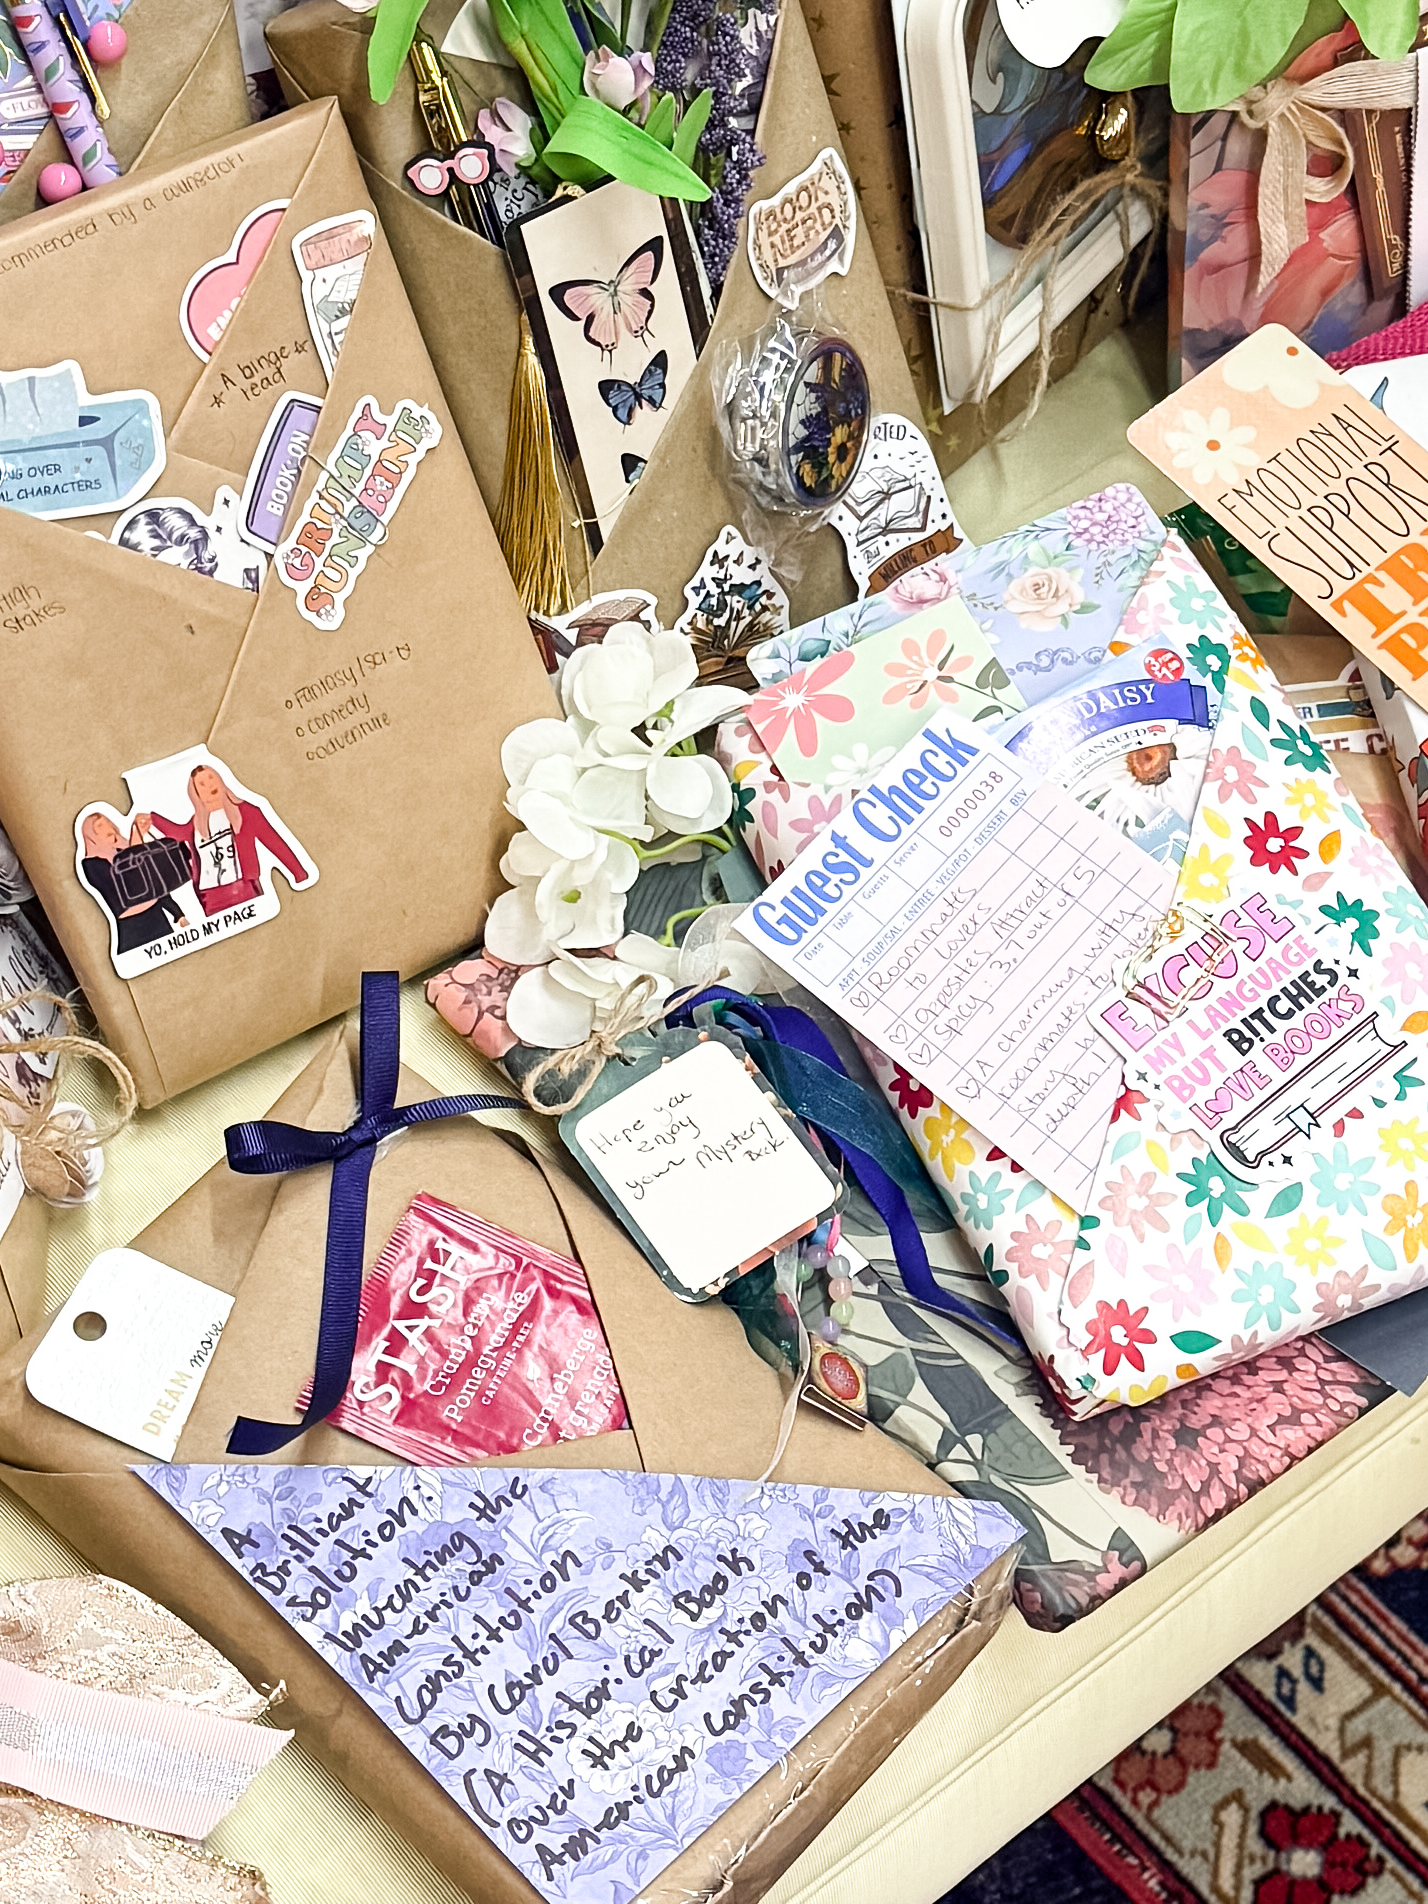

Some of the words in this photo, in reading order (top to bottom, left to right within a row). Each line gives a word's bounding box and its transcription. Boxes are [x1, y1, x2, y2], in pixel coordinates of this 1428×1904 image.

[108, 204, 138, 228] by
[143, 196, 156, 212] a
[765, 171, 831, 235] BOOK
[770, 201, 837, 269] NERD
[219, 372, 237, 392] A
[237, 343, 292, 387] binge
[238, 367, 288, 402] read
[17, 479, 102, 501] CHARACTERS
[27, 464, 63, 478] OVER
[282, 402, 388, 582] GRUMPY
[305, 406, 432, 617] SUNSHINE
[1217, 403, 1400, 540] EMOTIONAL
[877, 548, 923, 584] WILLING
[924, 539, 937, 557] TO
[1076, 683, 1157, 720] DAISY
[752, 831, 875, 947] Guest
[852, 725, 981, 845] Check
[938, 769, 1005, 839] 0000038
[904, 887, 936, 924] ENTREE
[975, 809, 1010, 849] DESSERT
[1074, 865, 1096, 887] 5
[168, 928, 200, 950] HOLD
[203, 919, 220, 937] MY
[223, 904, 256, 929] PAGE
[869, 884, 978, 996] Roommates
[905, 970, 928, 992] to
[1100, 892, 1296, 1053] EXCUSE
[1143, 1032, 1188, 1076] MY
[1186, 934, 1318, 1041] LANGUAGE
[1263, 984, 1365, 1072] BOOKS
[653, 1092, 693, 1127] you
[1163, 1044, 1228, 1104] BUT
[625, 1158, 686, 1200] your
[695, 1116, 774, 1169] Mystery
[352, 1237, 478, 1416] STASH
[426, 1292, 499, 1397] Cranberry
[443, 1290, 529, 1423] Pomegranate
[481, 1321, 534, 1406] CAFFEINE-FREE
[142, 1370, 194, 1437] DREAM
[522, 1326, 599, 1447] Canneberge
[220, 1526, 260, 1559] A
[250, 1476, 373, 1597] Brilliant
[324, 1530, 482, 1653] Inventing
[468, 1475, 529, 1524] the
[358, 1552, 505, 1683] American
[430, 1712, 492, 1762] By
[487, 1632, 575, 1717] Carol
[572, 1544, 684, 1641] Berkin
[581, 1721, 644, 1771] the
[794, 1550, 833, 1593] of
[828, 1508, 893, 1552] the
[464, 1765, 518, 1828] (A
[514, 1618, 675, 1768] Historical
[672, 1546, 756, 1623] Book
[534, 1746, 697, 1883] American
